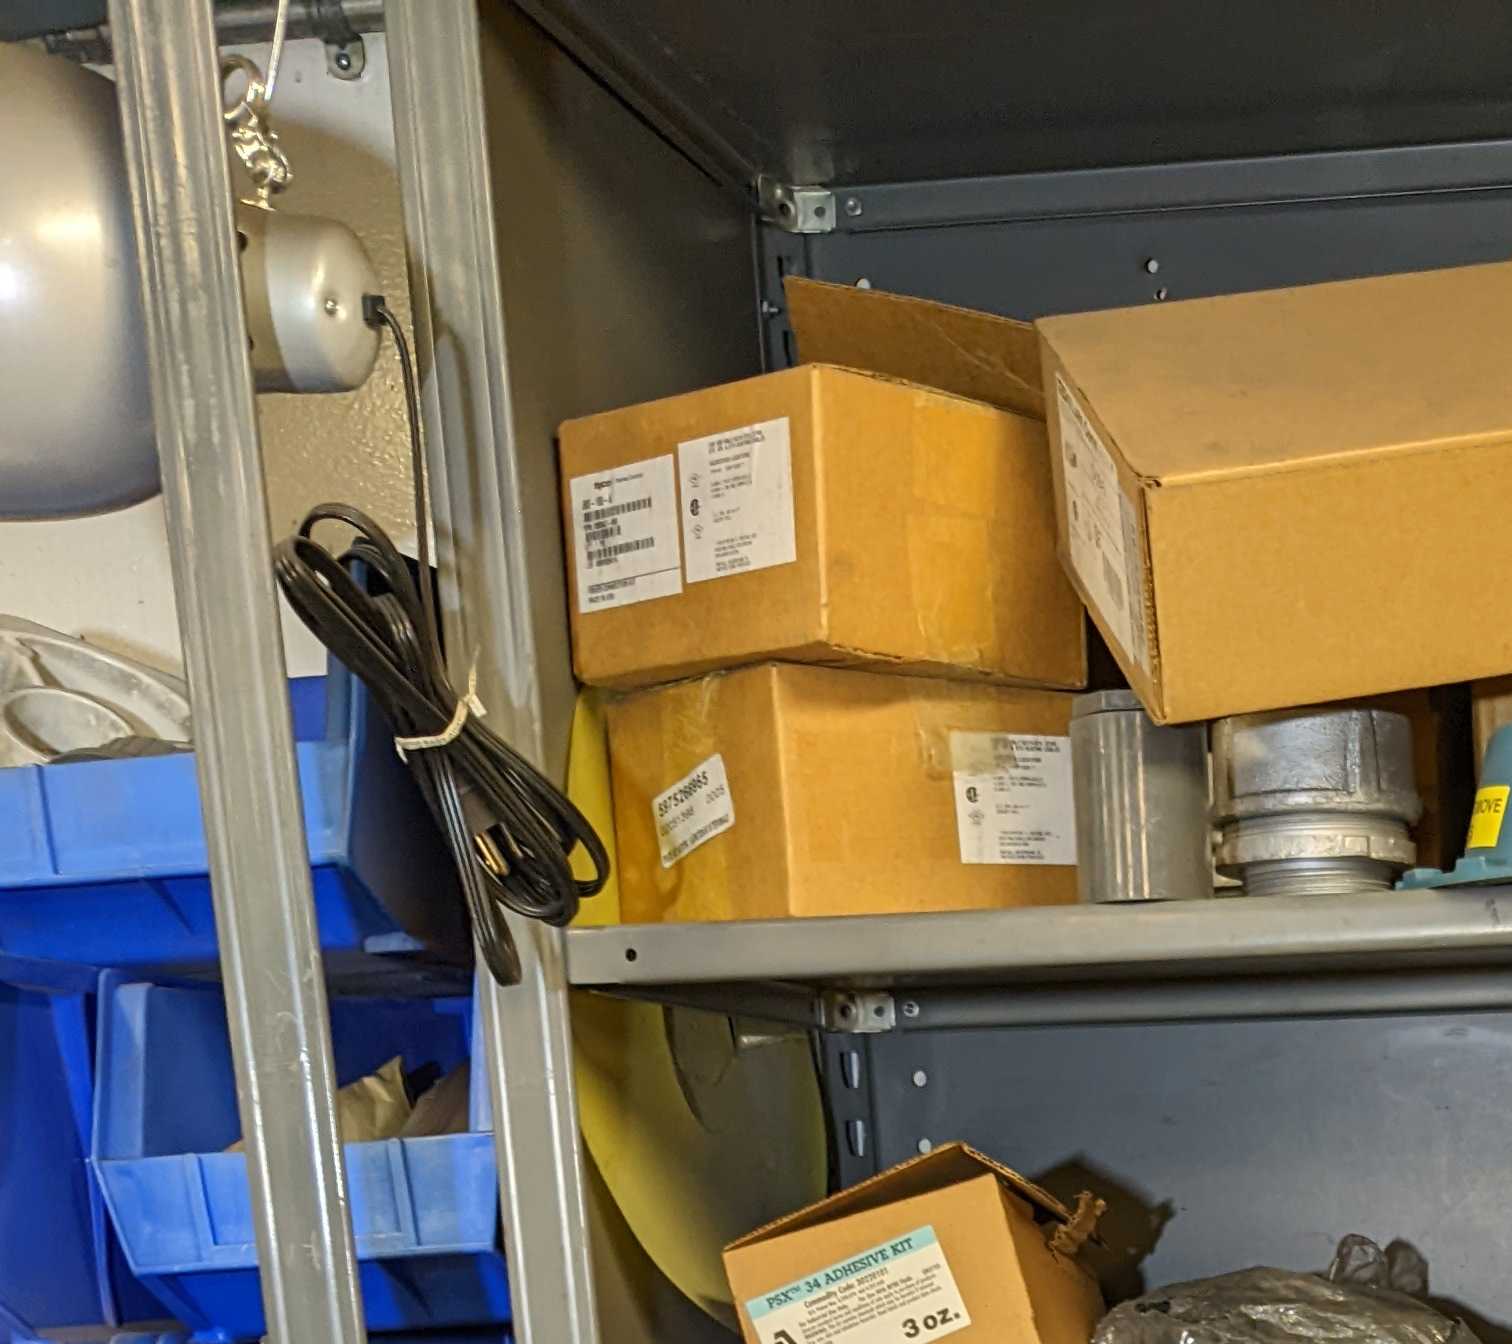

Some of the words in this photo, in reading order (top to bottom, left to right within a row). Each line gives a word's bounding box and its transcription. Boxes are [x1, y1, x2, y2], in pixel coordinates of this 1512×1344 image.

[805, 1278, 821, 1294] 34
[824, 1248, 890, 1286] ADHESIVE
[889, 1237, 914, 1254] KIT
[902, 1318, 920, 1339] 3
[922, 1307, 961, 1331] oz.
